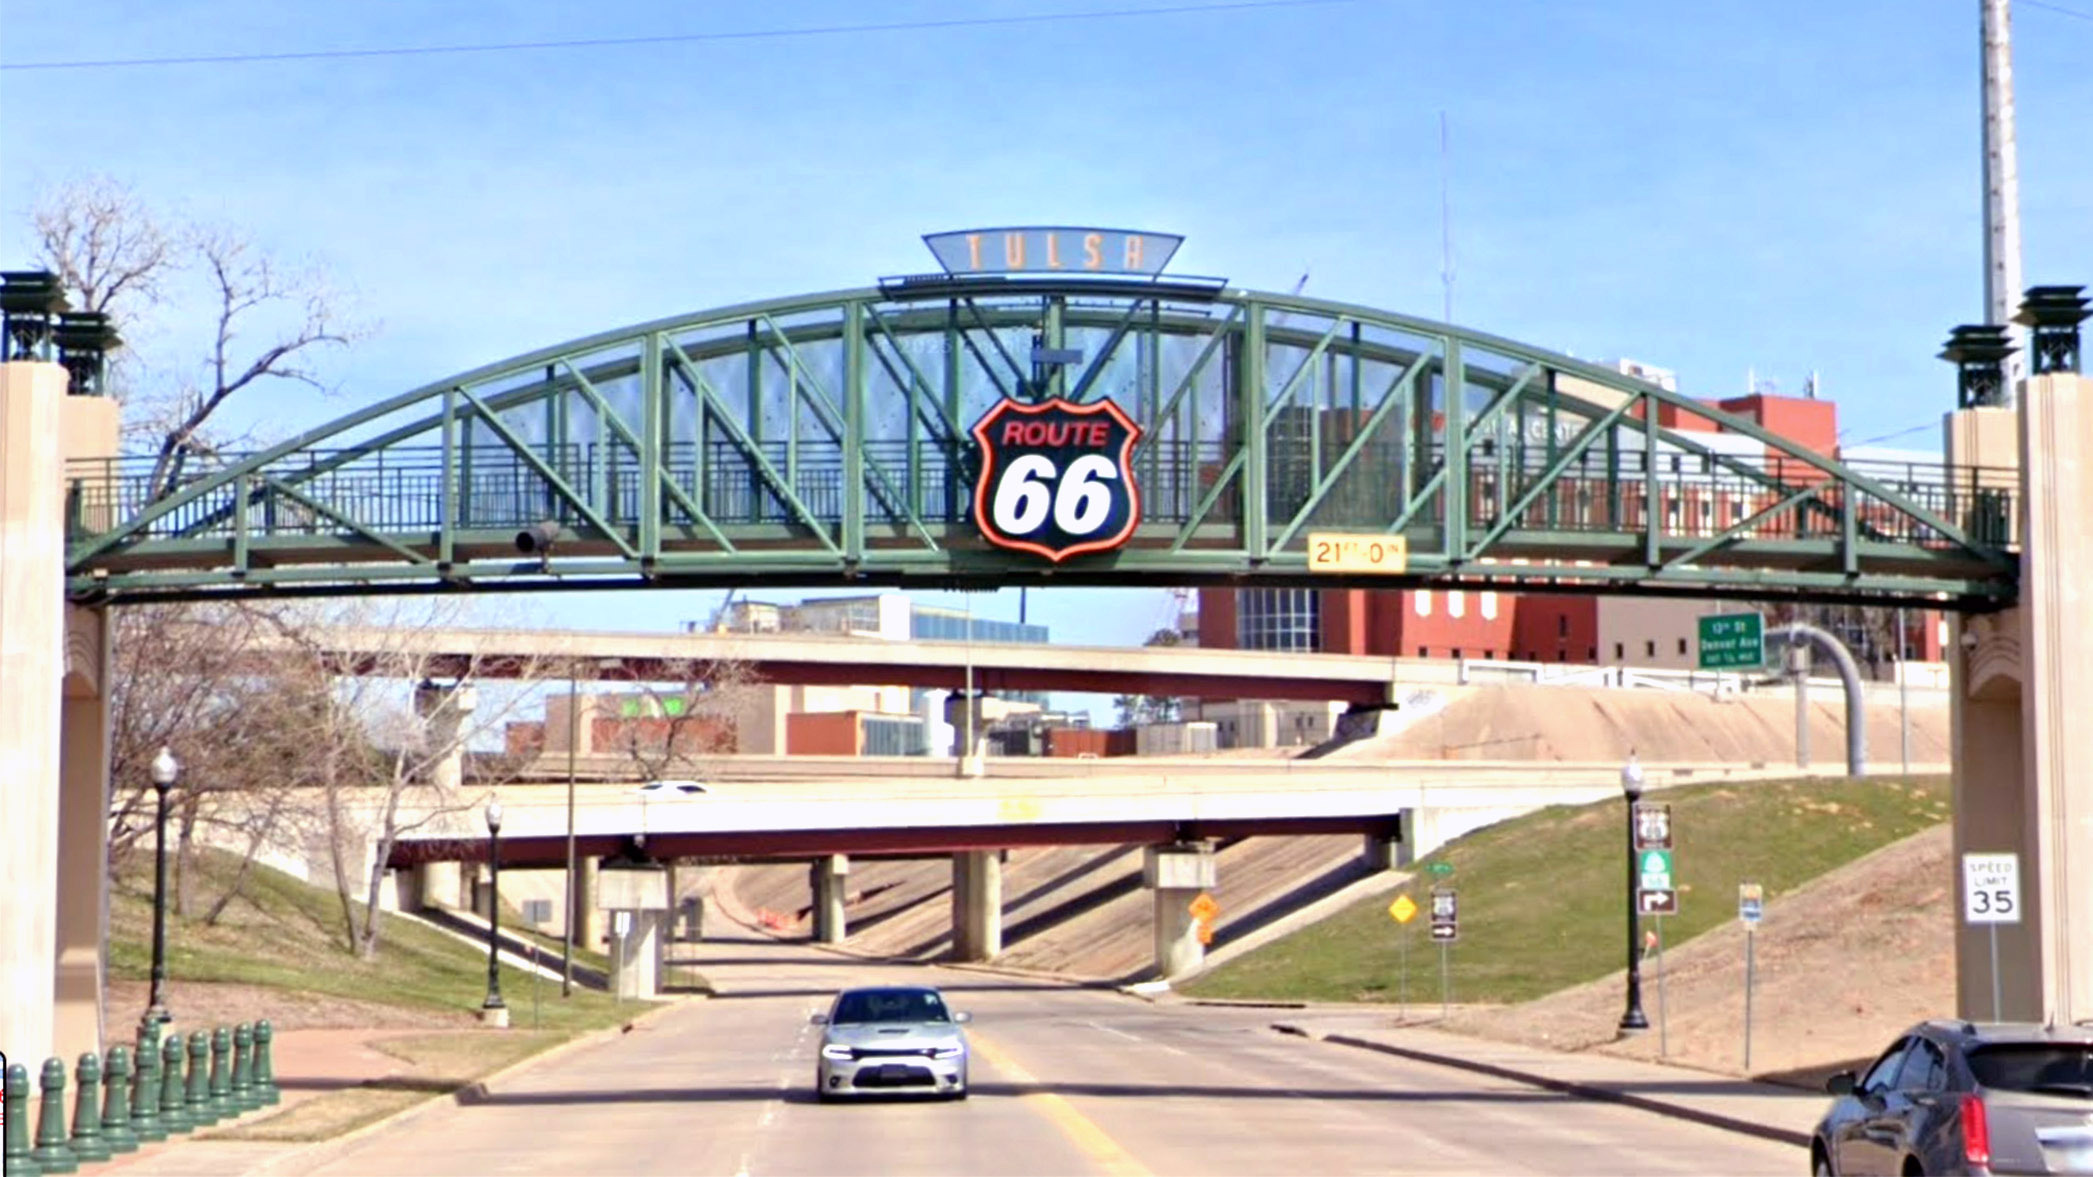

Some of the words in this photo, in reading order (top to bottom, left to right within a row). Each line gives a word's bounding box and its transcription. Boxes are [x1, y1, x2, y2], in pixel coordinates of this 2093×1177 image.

[966, 234, 1144, 270] TULSA
[1002, 421, 1111, 446] ROUTE
[993, 454, 1117, 535] 66
[1970, 862, 2012, 873] SPEED
[1973, 890, 2013, 914] 35
